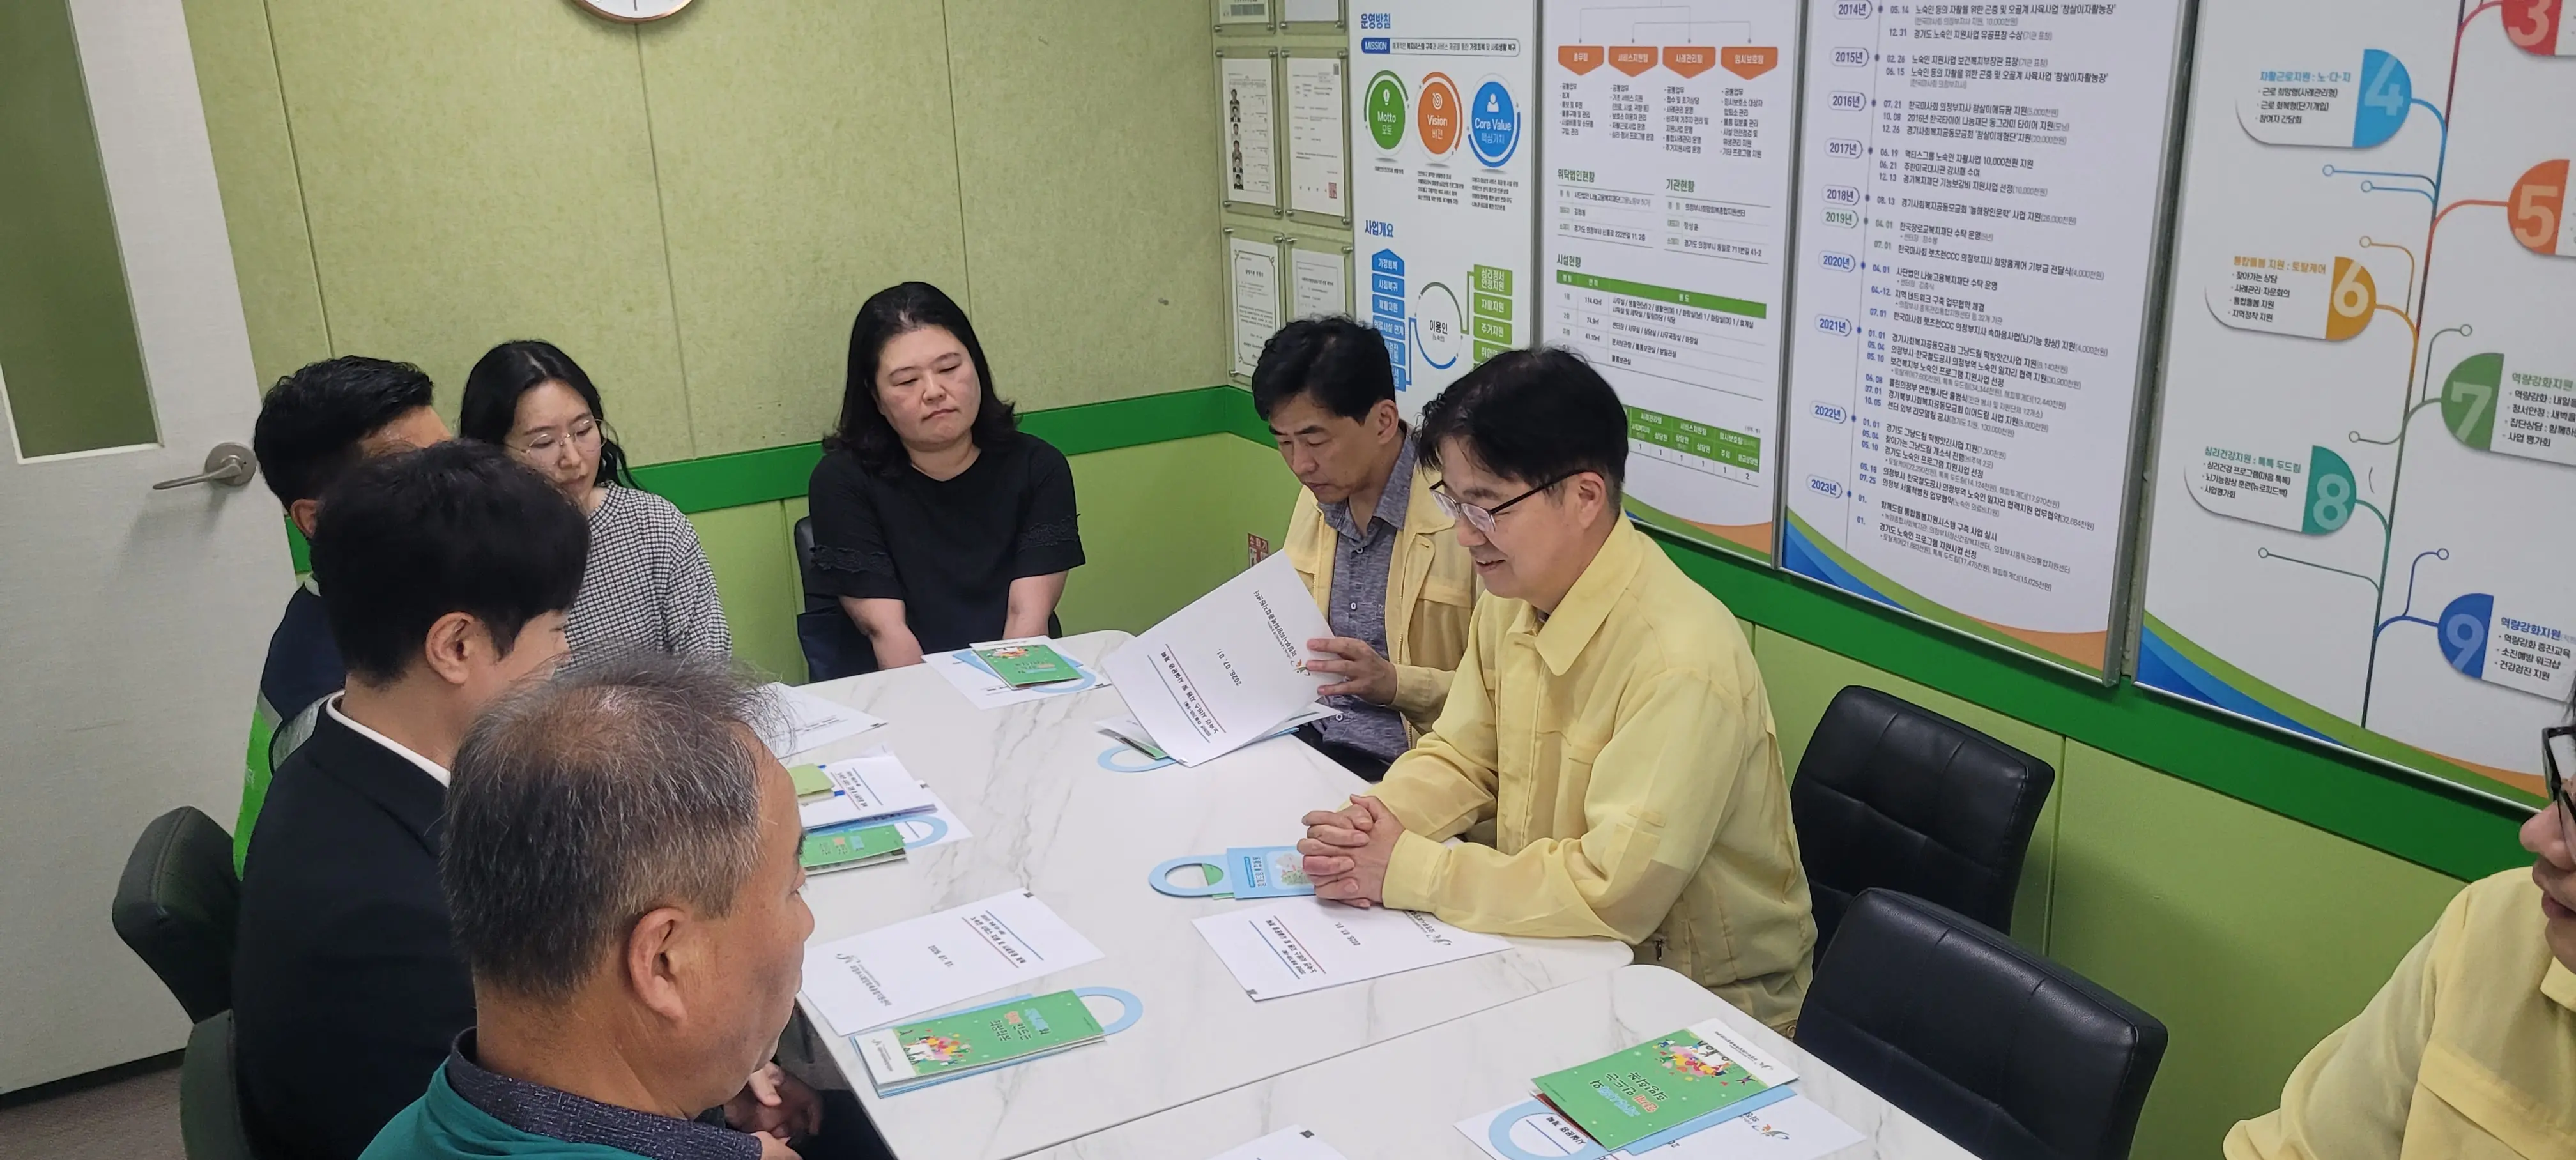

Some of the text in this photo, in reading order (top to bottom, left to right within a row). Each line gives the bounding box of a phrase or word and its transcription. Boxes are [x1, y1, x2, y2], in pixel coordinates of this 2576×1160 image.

[1838, 3, 1866, 15] 2014년
[1915, 5, 1933, 14] 노숙인
[1936, 5, 1947, 14] 등의
[1949, 5, 1968, 14] 자활을
[1971, 5, 1982, 14] 위한
[1985, 5, 1997, 14] 곤충
[2000, 5, 2005, 13] 및
[2008, 5, 2028, 14] 오골계
[2030, 5, 2058, 14] 사육사업
[1361, 13, 1390, 29] 운영방침
[2508, 0, 2552, 46] 3
[1365, 42, 1387, 50] MISSION
[1835, 51, 1863, 63] 2015년
[2262, 88, 2276, 96] 근로
[2365, 54, 2404, 116] 4
[1832, 95, 1860, 107] 2016년
[2260, 100, 2274, 110] 근로
[1377, 111, 1396, 122] Motto
[1428, 115, 1447, 125] Vision
[1907, 114, 1928, 123] 2016년
[1930, 115, 1960, 124] 한국타이어
[1962, 116, 1987, 126] 나눔재단
[1989, 118, 2015, 128] 동그라미
[2018, 119, 2037, 129] 타이어
[2259, 114, 2302, 123] 참여자 간담회
[1475, 118, 1511, 131] Core Value
[1432, 130, 1443, 139] 비전
[1482, 133, 1505, 144] 핵심가치
[1829, 142, 1857, 155] 2017년
[1558, 168, 1595, 183] 위탁법인현황
[1666, 178, 1694, 192] 기관현황
[1827, 188, 1853, 202] 2018년
[1888, 197, 1894, 205] 13
[1901, 198, 1966, 213] 경기사회복지공동모금회
[2012, 210, 2025, 220] 사업
[2515, 184, 2558, 247] 5
[1825, 211, 1852, 225] 2019년
[1365, 220, 1393, 237] 사업개요
[1379, 259, 1397, 271] 가정회복
[1557, 254, 1581, 268] 시설현황
[1823, 254, 1850, 268] 2020년
[2267, 259, 2285, 270] 지원
[1482, 269, 1504, 279] 심리정서
[1896, 267, 1919, 279] 사단법인
[1920, 271, 1968, 286] 나눔고용복지재단
[1970, 279, 1983, 288] 수탁
[1984, 280, 1997, 291] 운영
[2235, 271, 2278, 283] 찾아가는 상담
[1379, 280, 1398, 291] 사회복귀
[1482, 279, 1505, 292] 안정지원
[2331, 260, 2369, 317] 6
[1482, 301, 1504, 312] 자활지원
[1895, 289, 1906, 299] 지역
[1908, 291, 1931, 303] 네트워크
[1932, 296, 1944, 305] 구축
[1946, 298, 1970, 310] 업무협약
[1972, 301, 1984, 312] 체결
[2260, 300, 2274, 309] 지원
[2232, 309, 2273, 322] 지역정착 지원
[1430, 320, 1447, 334] 이용인
[1482, 323, 1503, 337] 주거지원
[1819, 317, 1846, 332] 2021년
[2511, 372, 2573, 392] 역량강화지원
[2513, 389, 2547, 403] 역량강화
[1814, 404, 1841, 420] 2022년
[2451, 381, 2492, 441] 7
[2511, 404, 2545, 418] 정서안정
[2510, 418, 2543, 432] 집단상담
[2507, 431, 2551, 447] 사업 평가회
[2205, 446, 2251, 464] 심리건강지원
[2207, 461, 2232, 473] 심리건강
[2233, 466, 2274, 482] 프로그램(마음
[1811, 478, 1836, 495] 2023년
[2205, 473, 2237, 487] 뇌기능향상
[2204, 485, 2235, 498] 사업평가회
[2313, 473, 2350, 530] 8
[1857, 515, 1976, 559] 01. 경기도 노숙인 프로그램 지원사업 선정
[2446, 613, 2485, 671] 9
[2503, 634, 2571, 658] 역량강화 증진교육
[1160, 650, 1171, 663] 계획
[2501, 647, 2534, 663] 소진예방
[1222, 658, 1232, 669] 07.
[2499, 659, 2550, 681] 건강검진 지원
[1167, 662, 1184, 684] 시설운영
[1186, 691, 1197, 702] 지원
[1193, 702, 1208, 719] 서비스
[1204, 718, 1219, 735] 노숙인
[1603, 1072, 1637, 1097] 만드는
[1626, 1071, 1668, 1101] 희망회복
[1558, 1126, 1586, 1145] 시설운영
